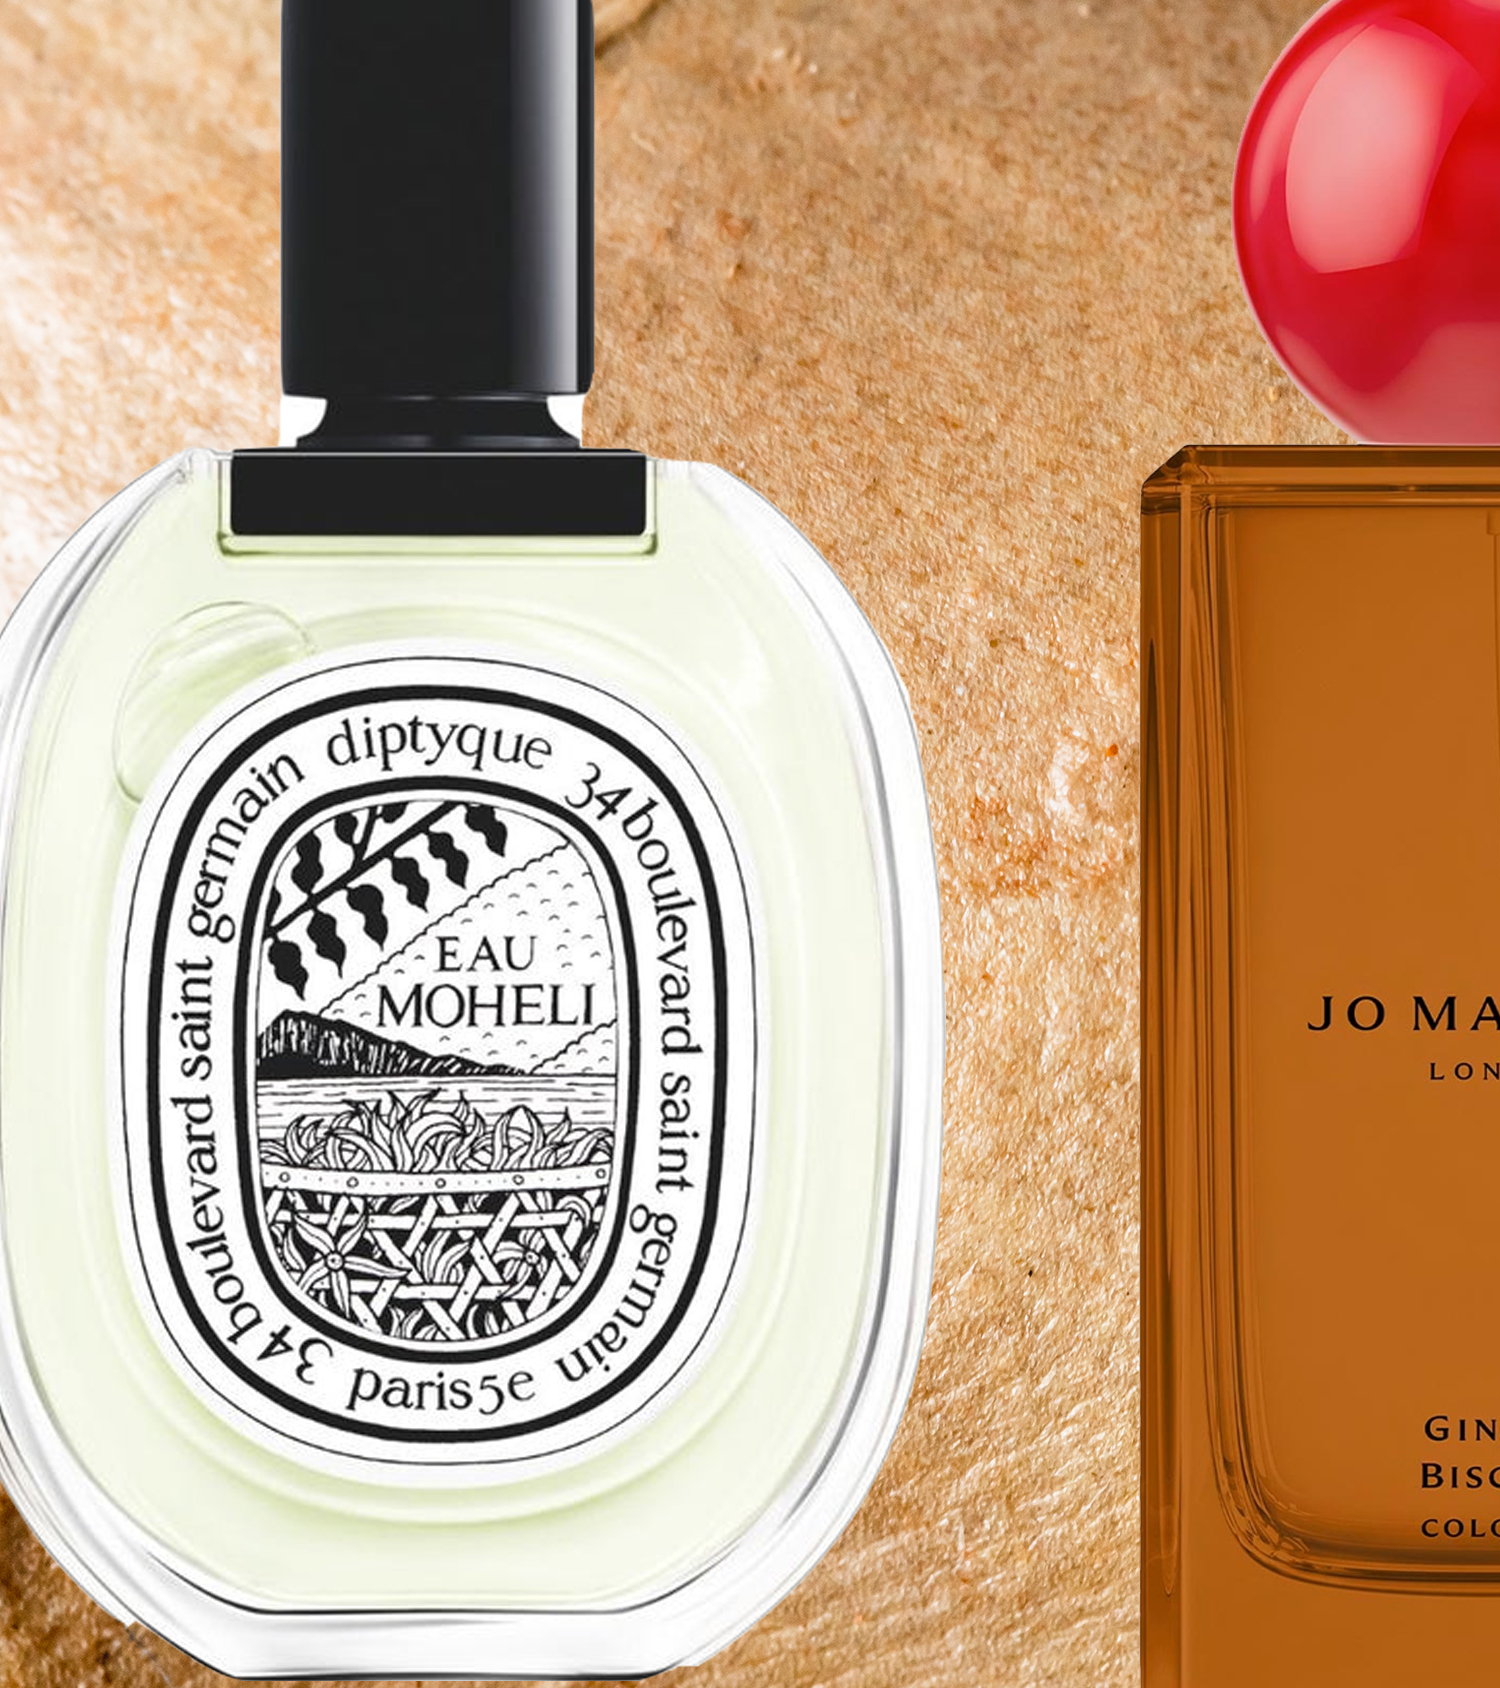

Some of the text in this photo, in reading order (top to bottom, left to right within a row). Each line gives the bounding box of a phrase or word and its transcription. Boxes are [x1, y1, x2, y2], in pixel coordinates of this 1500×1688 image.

[327, 715, 552, 772] diptyque
[187, 754, 305, 944] germain
[436, 936, 538, 972] EAU
[171, 955, 214, 1081] saint
[377, 983, 594, 1029] MOHELI
[1307, 995, 1386, 1031] JO
[656, 1072, 700, 1194] saint
[554, 1203, 678, 1382] germain
